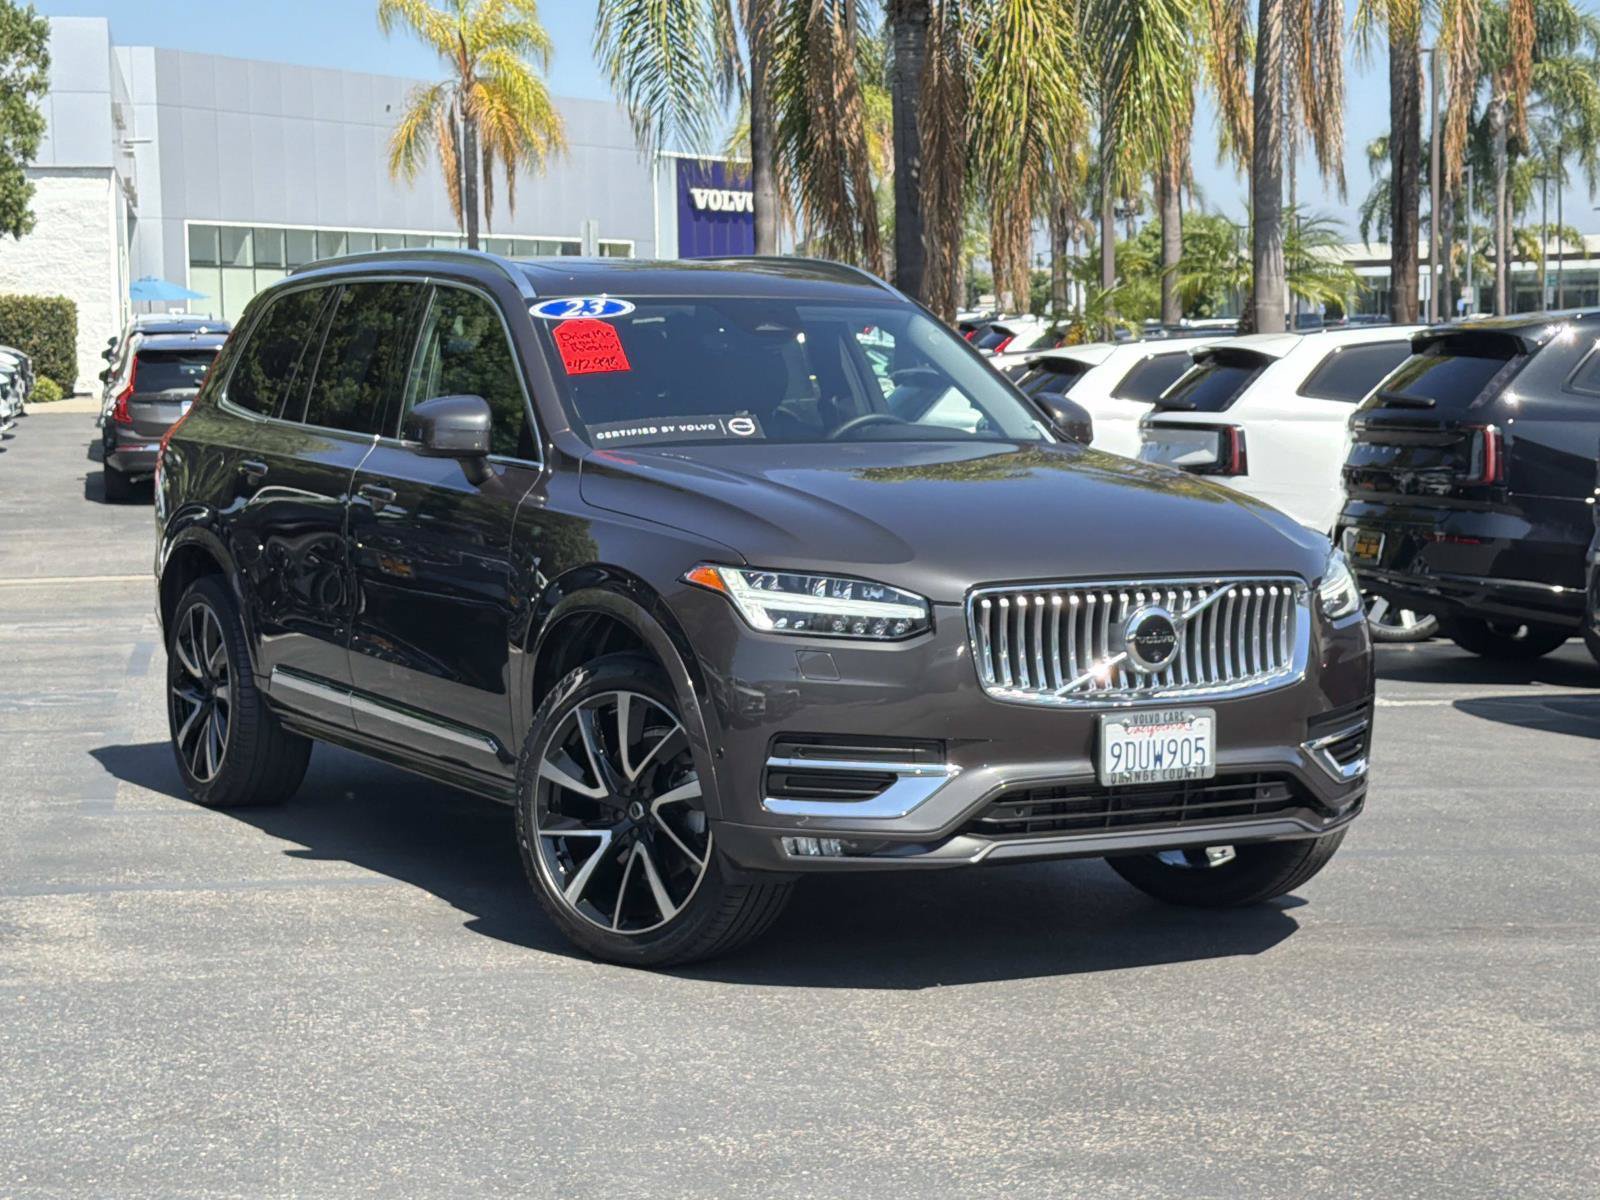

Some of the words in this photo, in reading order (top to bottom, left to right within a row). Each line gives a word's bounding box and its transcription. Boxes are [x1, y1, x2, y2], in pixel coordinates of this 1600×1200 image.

[560, 299, 606, 316] 23
[596, 426, 657, 440] CERTIFIED
[661, 425, 675, 433] BY
[679, 423, 716, 432] VOLVO
[1133, 714, 1160, 725] VOLVO
[1163, 711, 1185, 722] CARS
[1110, 737, 1206, 772] 9DUW905
[1111, 769, 1157, 785] ORANGE
[1162, 765, 1207, 780] COUNTY
